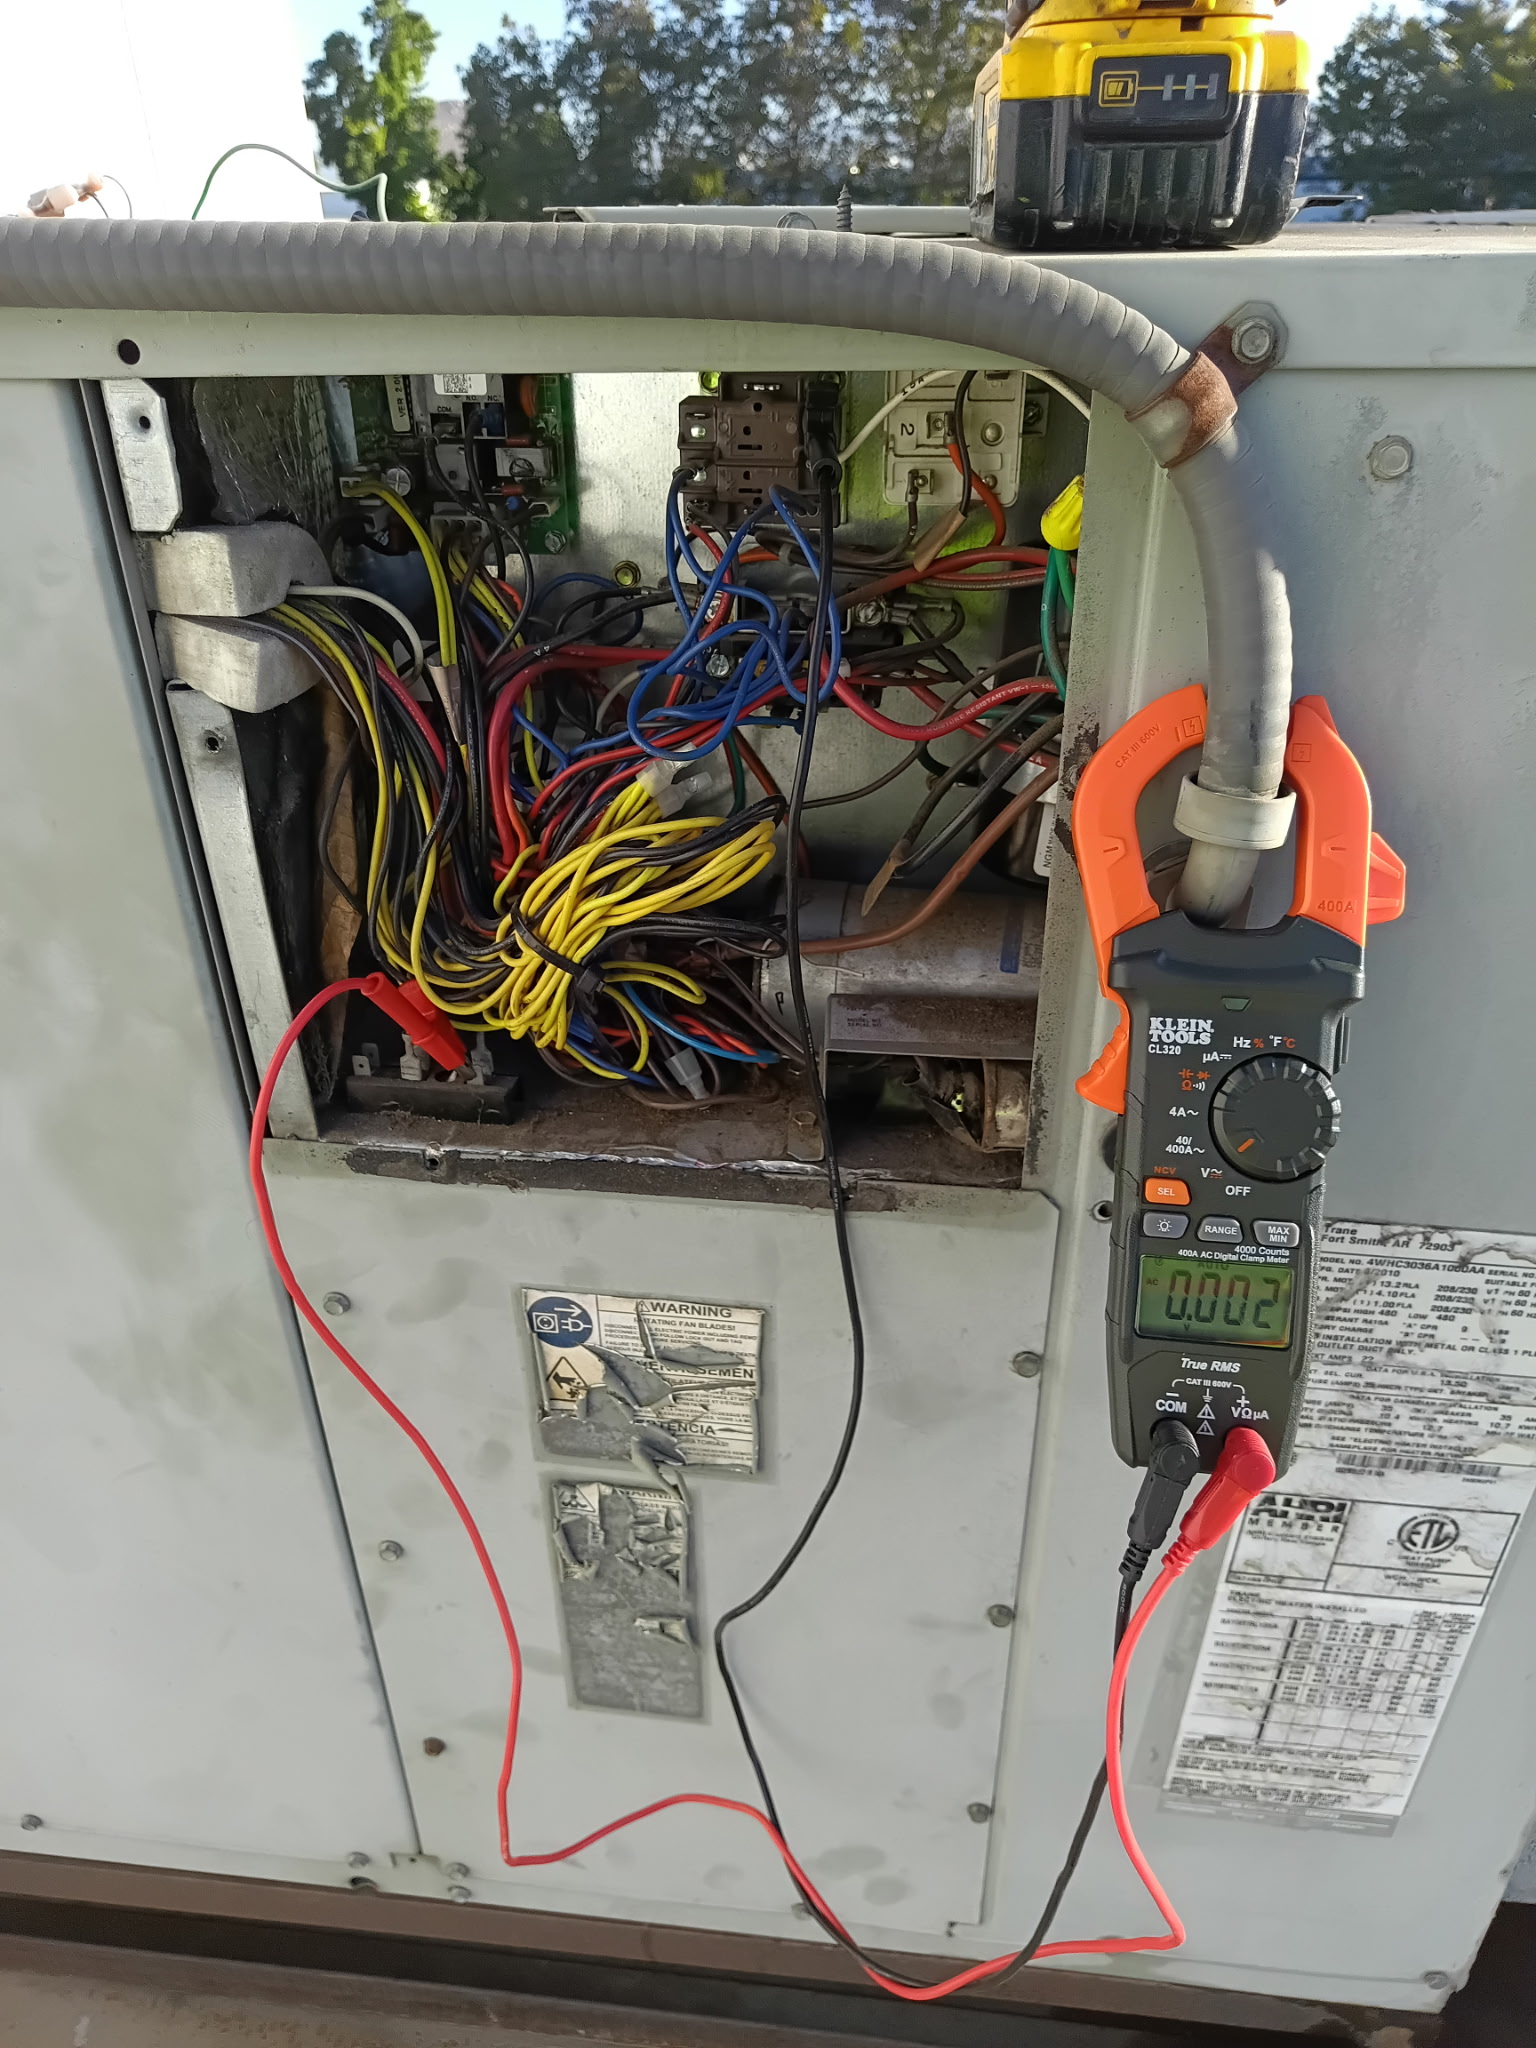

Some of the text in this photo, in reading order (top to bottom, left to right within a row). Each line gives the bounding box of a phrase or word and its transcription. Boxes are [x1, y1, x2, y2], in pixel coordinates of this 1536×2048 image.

[1115, 724, 1161, 768] CAT III 600V
[1317, 900, 1355, 915] 400A
[1149, 1029, 1212, 1045] TOOLS
[1233, 1036, 1252, 1050] Hz
[1148, 1043, 1182, 1055] CL320
[1154, 1166, 1177, 1175] NCV
[1157, 1185, 1251, 1197] SEL OFF
[1204, 1225, 1290, 1236] RANGE MAX
[1324, 1224, 1358, 1236] Trane
[1269, 1234, 1287, 1244] MIN
[1321, 1234, 1345, 1244] Fort
[1392, 1239, 1410, 1249] AR
[1418, 1241, 1455, 1252] 72903
[1178, 1249, 1290, 1264] 400A AC Digital Clamp Meter
[1234, 1245, 1290, 1256] 4000 Counts
[1488, 1269, 1519, 1278] SERIAL
[1436, 1284, 1479, 1295] 208/230
[1165, 1269, 1281, 1329] 0.002
[650, 1302, 732, 1318] WARNING
[604, 1323, 637, 1331] DISCONNEC
[604, 1328, 637, 1336] DISCONNEC
[1317, 1341, 1355, 1351] OUTLET
[1357, 1344, 1384, 1353] DUCT
[1322, 1334, 1392, 1346] INSTALLATION
[1424, 1342, 1457, 1352] METAL
[1460, 1345, 1476, 1353] OR
[1181, 1358, 1241, 1373] True RMS
[1185, 1377, 1232, 1389] CAT III 600V
[1155, 1399, 1187, 1414] COM
